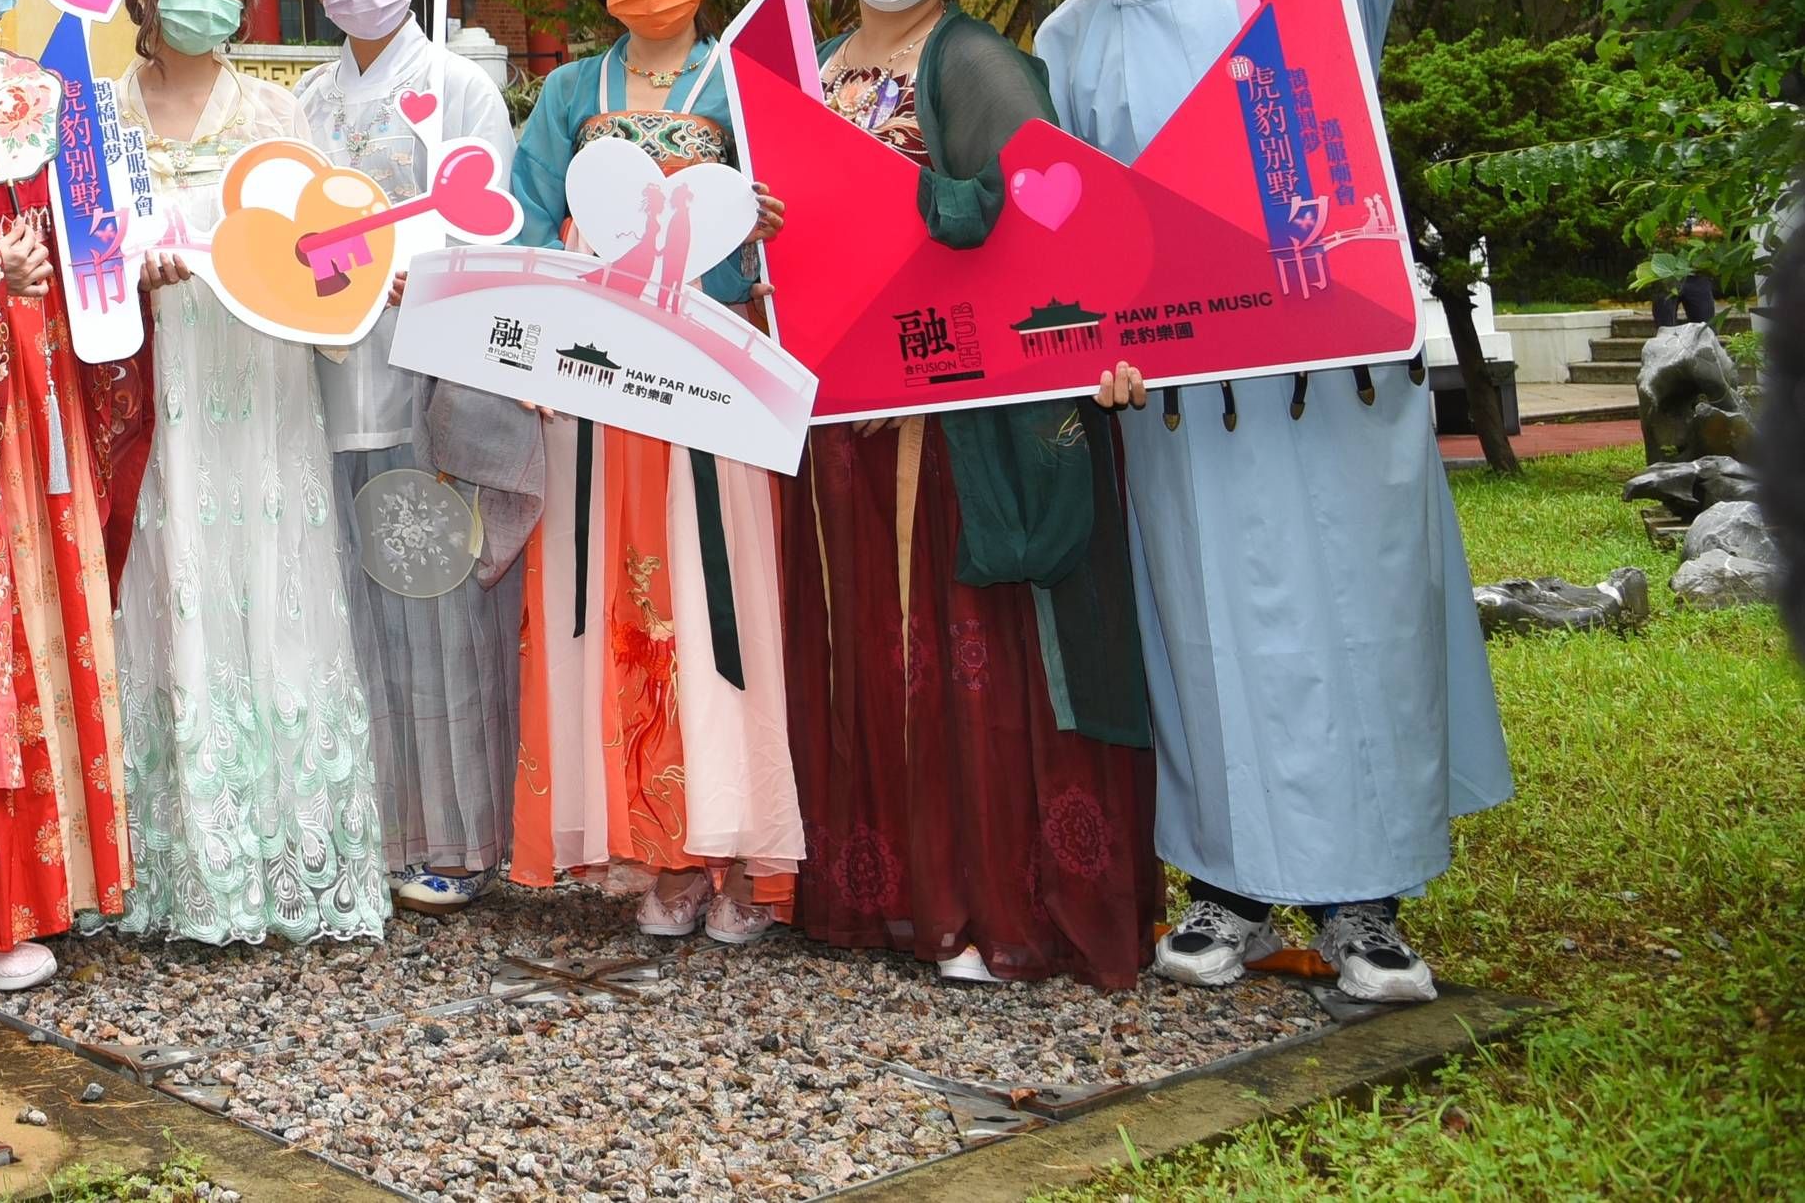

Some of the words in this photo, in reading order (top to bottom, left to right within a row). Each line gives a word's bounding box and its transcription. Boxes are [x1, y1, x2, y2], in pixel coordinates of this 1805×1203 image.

[1115, 306, 1159, 325] HAW
[1165, 300, 1202, 320] PAR
[1208, 291, 1273, 314] MUSIC
[490, 315, 523, 349] 融
[892, 307, 955, 362] 融
[914, 360, 957, 375] FUSION
[626, 368, 656, 384] HAW
[659, 377, 685, 392] PAR
[689, 384, 731, 405] MUSIC
